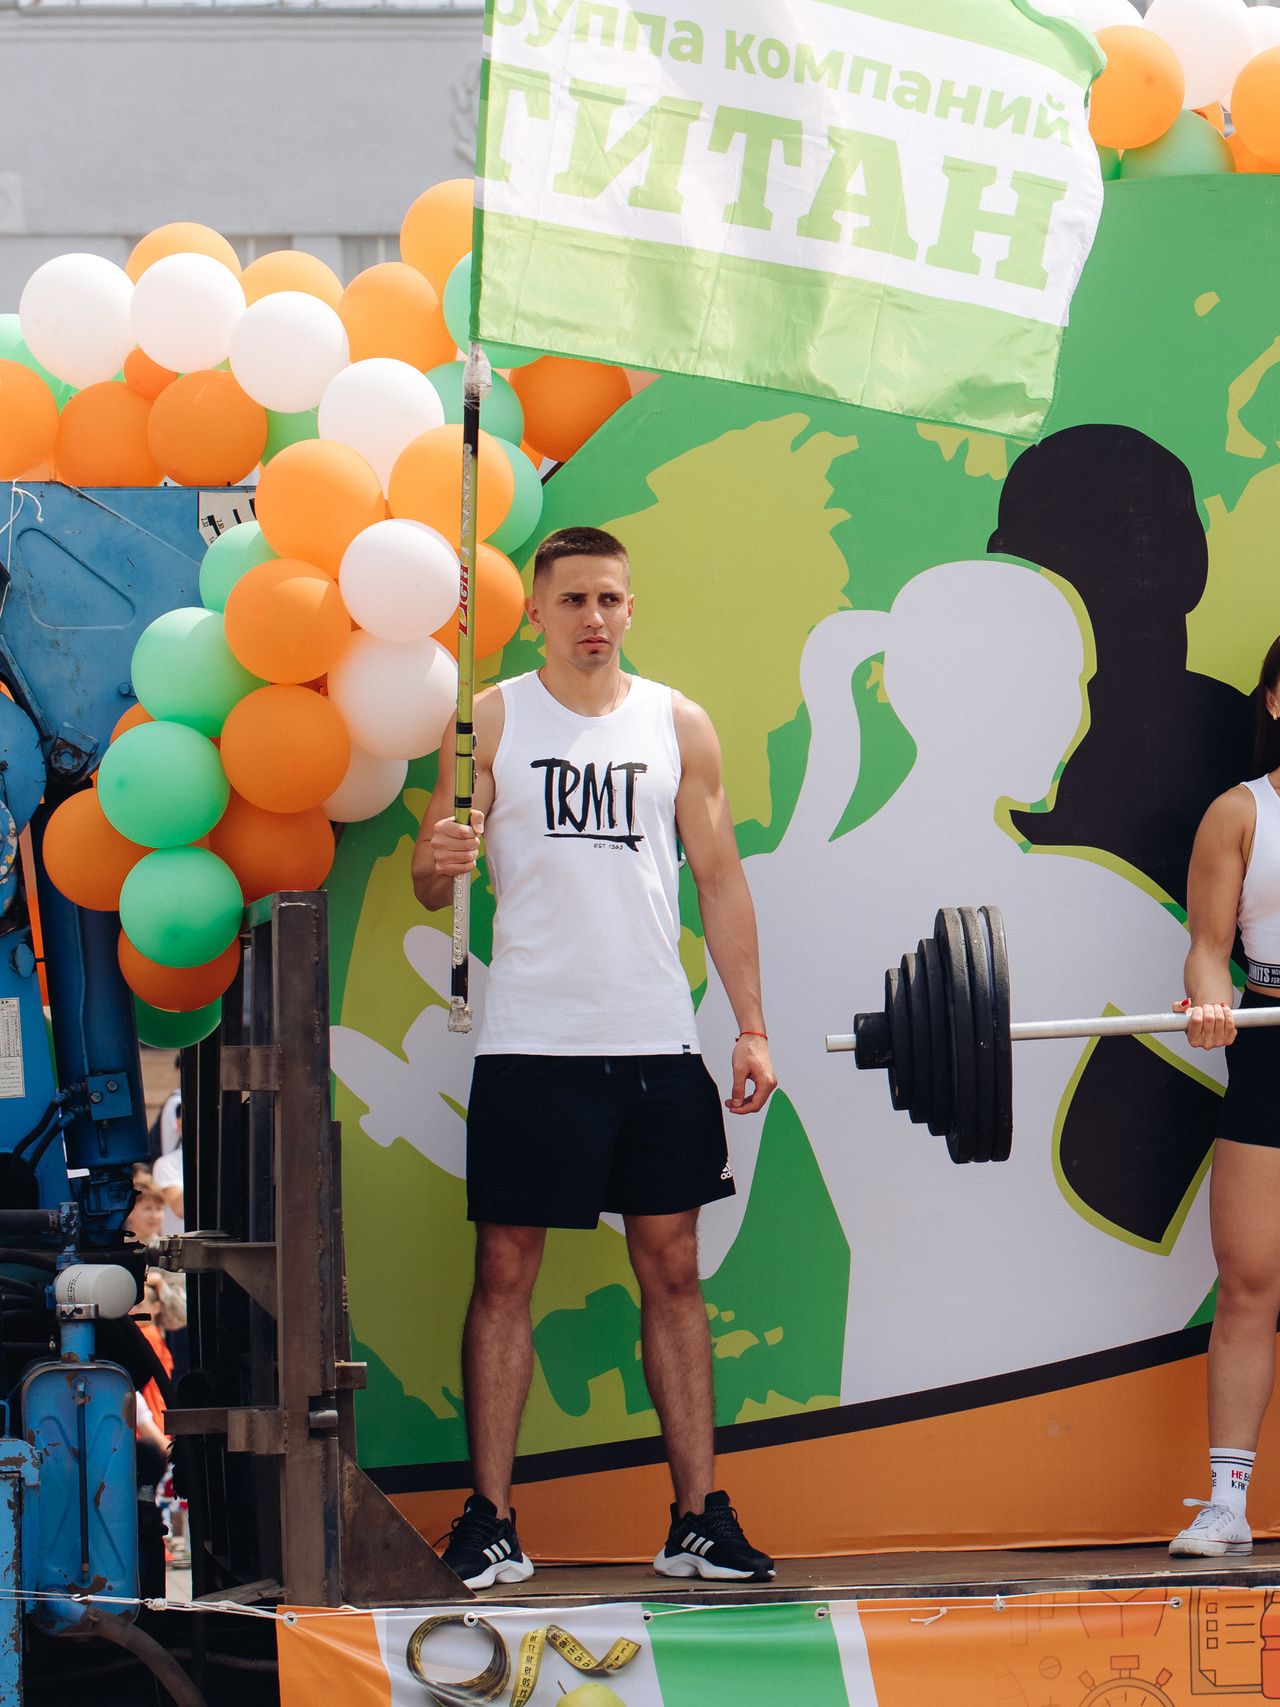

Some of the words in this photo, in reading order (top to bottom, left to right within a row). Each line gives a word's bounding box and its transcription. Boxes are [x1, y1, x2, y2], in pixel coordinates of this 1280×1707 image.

[725, 26, 1075, 149] компаний
[530, 757, 648, 842] TRMT
[1231, 1469, 1244, 1480] НЕ
